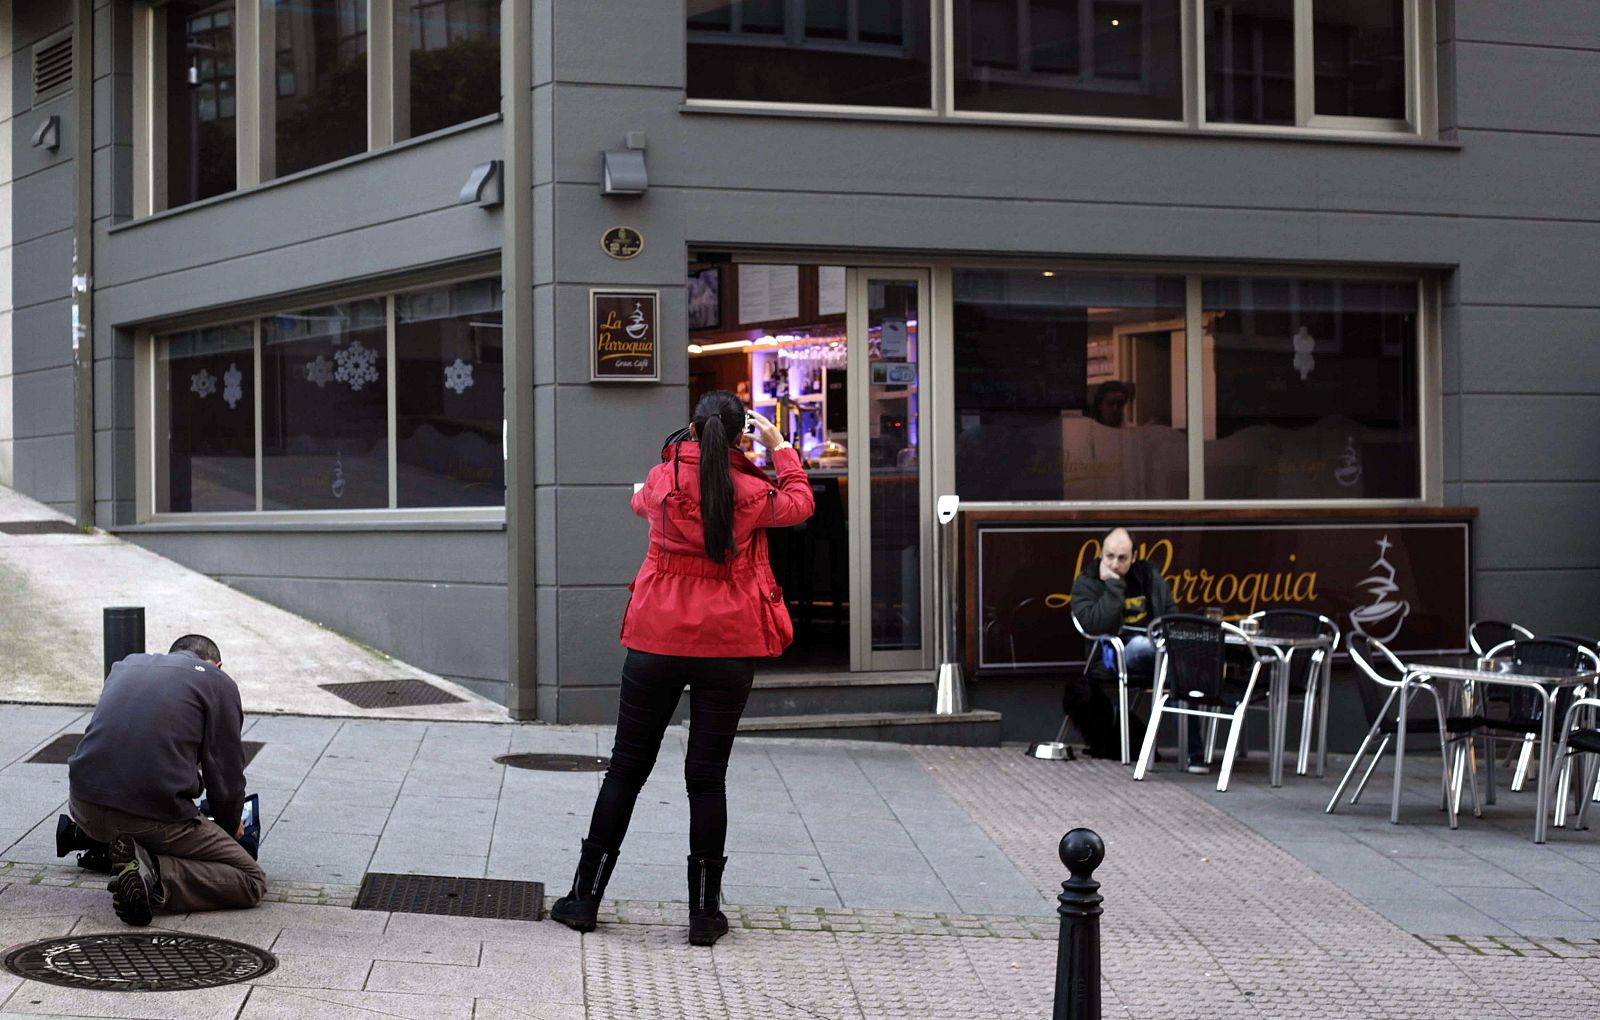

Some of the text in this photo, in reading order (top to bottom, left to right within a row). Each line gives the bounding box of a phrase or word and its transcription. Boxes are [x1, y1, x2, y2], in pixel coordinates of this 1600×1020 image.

[600, 310, 622, 330] La
[598, 332, 653, 354] Parroquia
[1045, 538, 1102, 609] L
